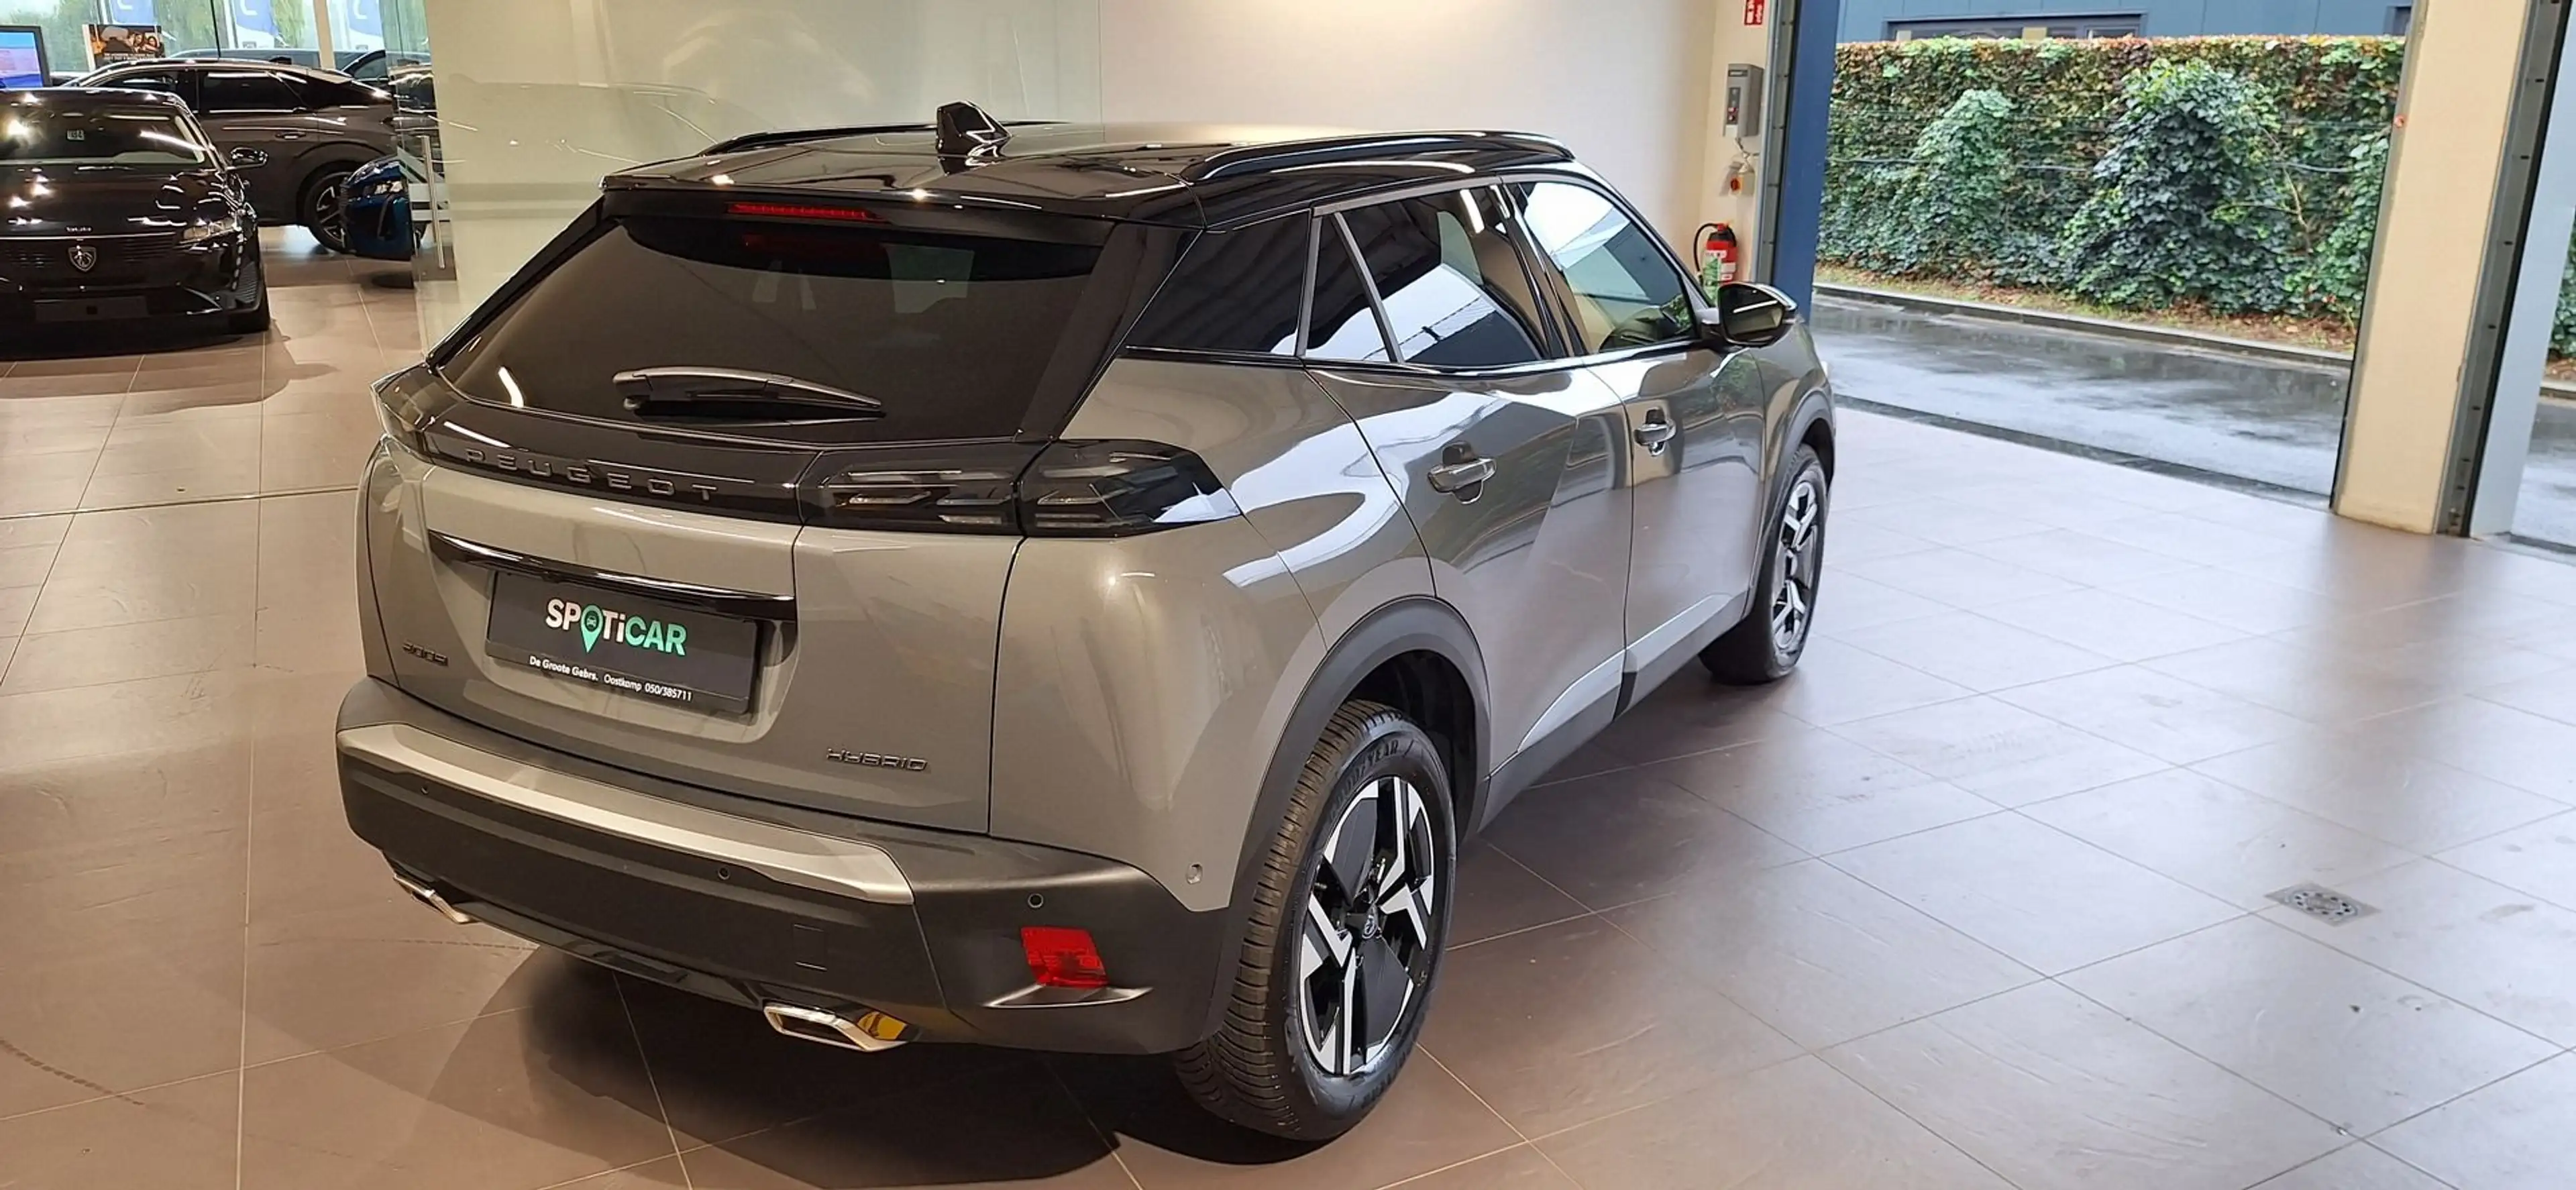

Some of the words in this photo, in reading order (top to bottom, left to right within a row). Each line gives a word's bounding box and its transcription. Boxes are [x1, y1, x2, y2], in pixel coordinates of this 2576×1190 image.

[465, 448, 717, 501] PEUGEOT
[529, 655, 541, 667] De
[541, 659, 571, 675] Groote
[572, 666, 599, 681] Gebrs.
[604, 673, 642, 692] Oostkamp
[644, 682, 693, 702] 050/385711
[826, 748, 928, 771] HYBRID
